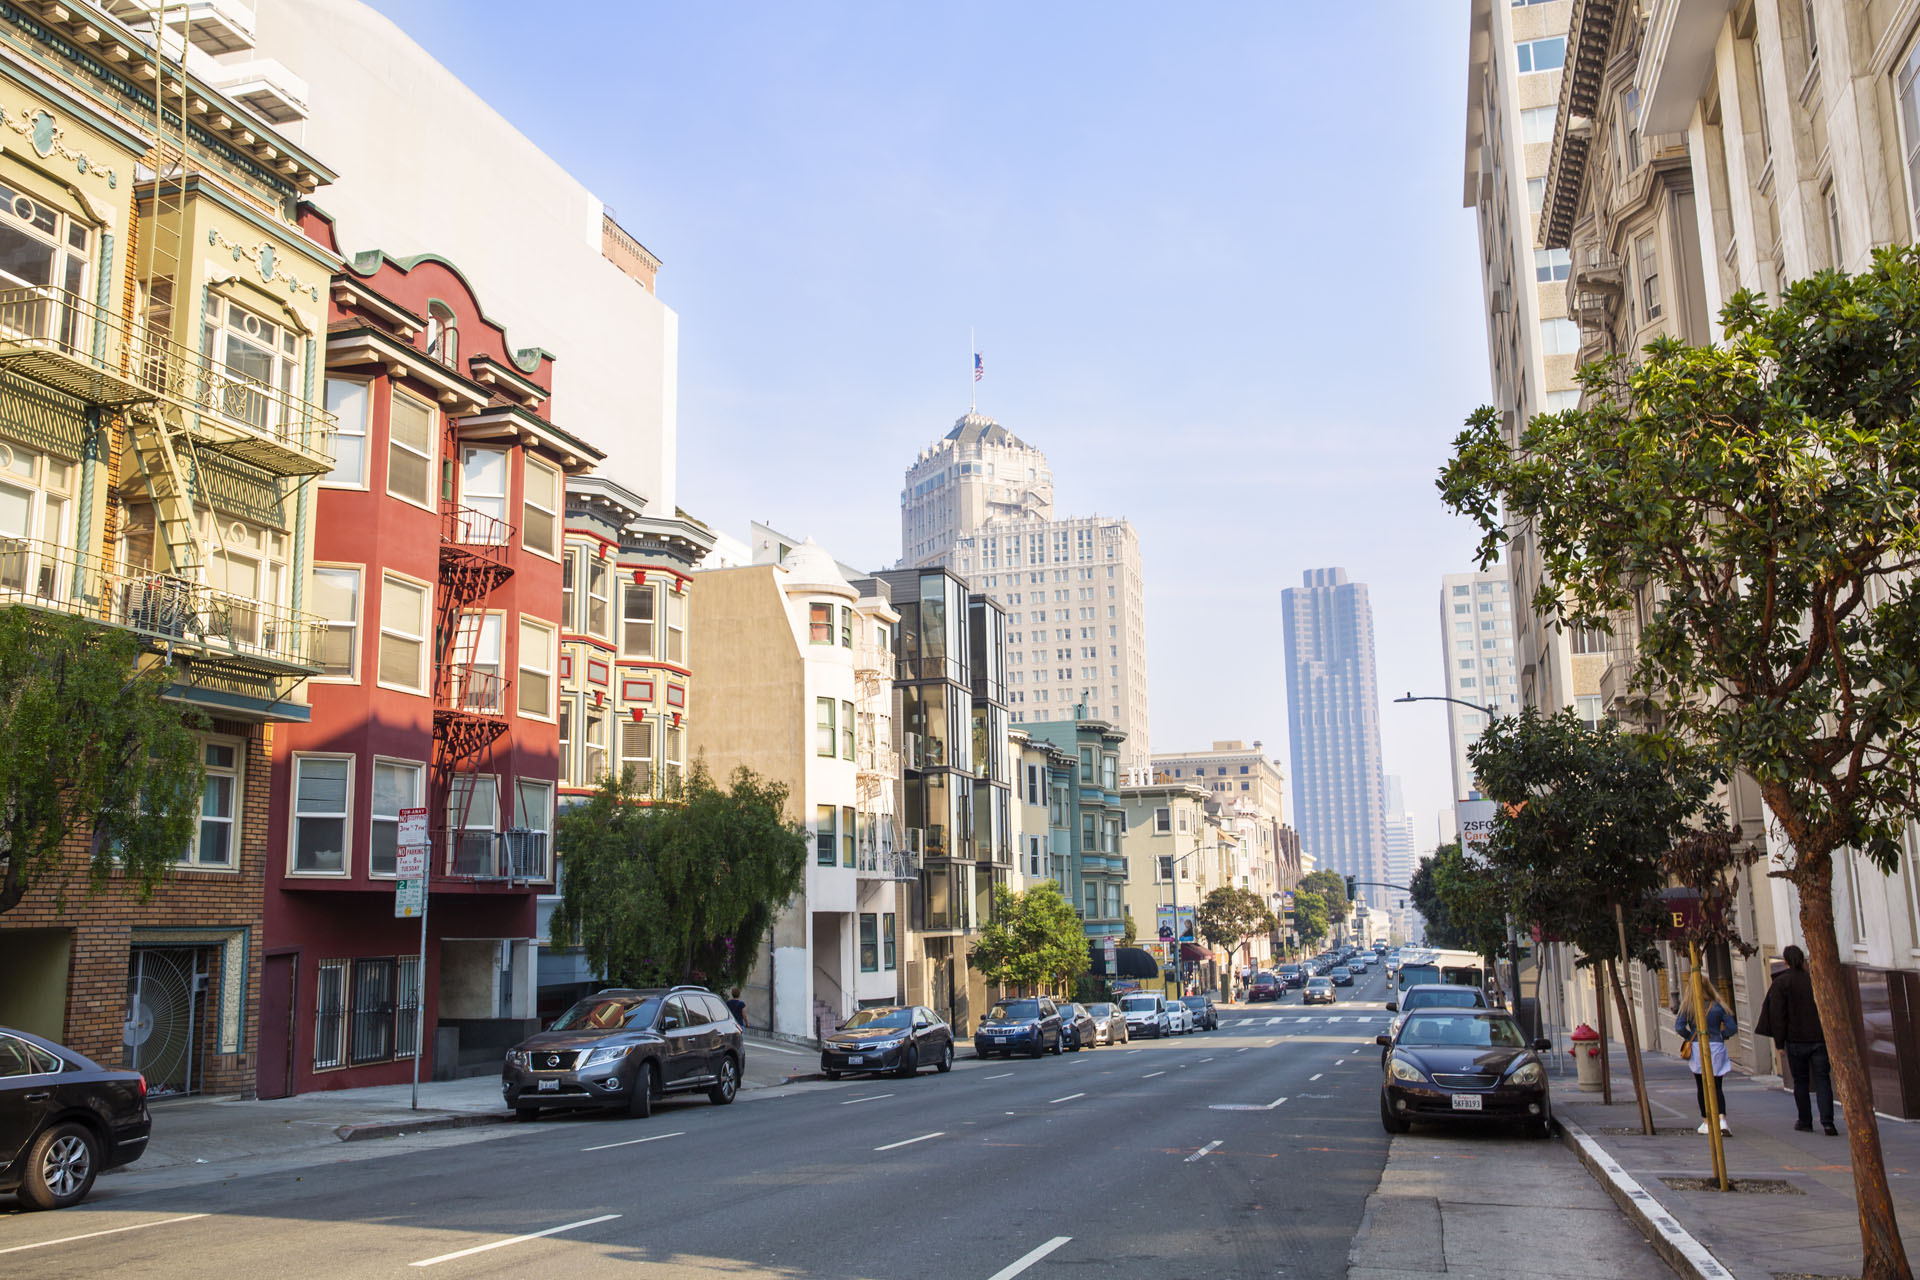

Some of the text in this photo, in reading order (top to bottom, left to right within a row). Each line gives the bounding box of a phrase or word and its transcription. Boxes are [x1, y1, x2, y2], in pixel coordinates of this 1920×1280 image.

[399, 815, 407, 823] NO
[397, 847, 406, 856] NO
[399, 881, 405, 889] 2
